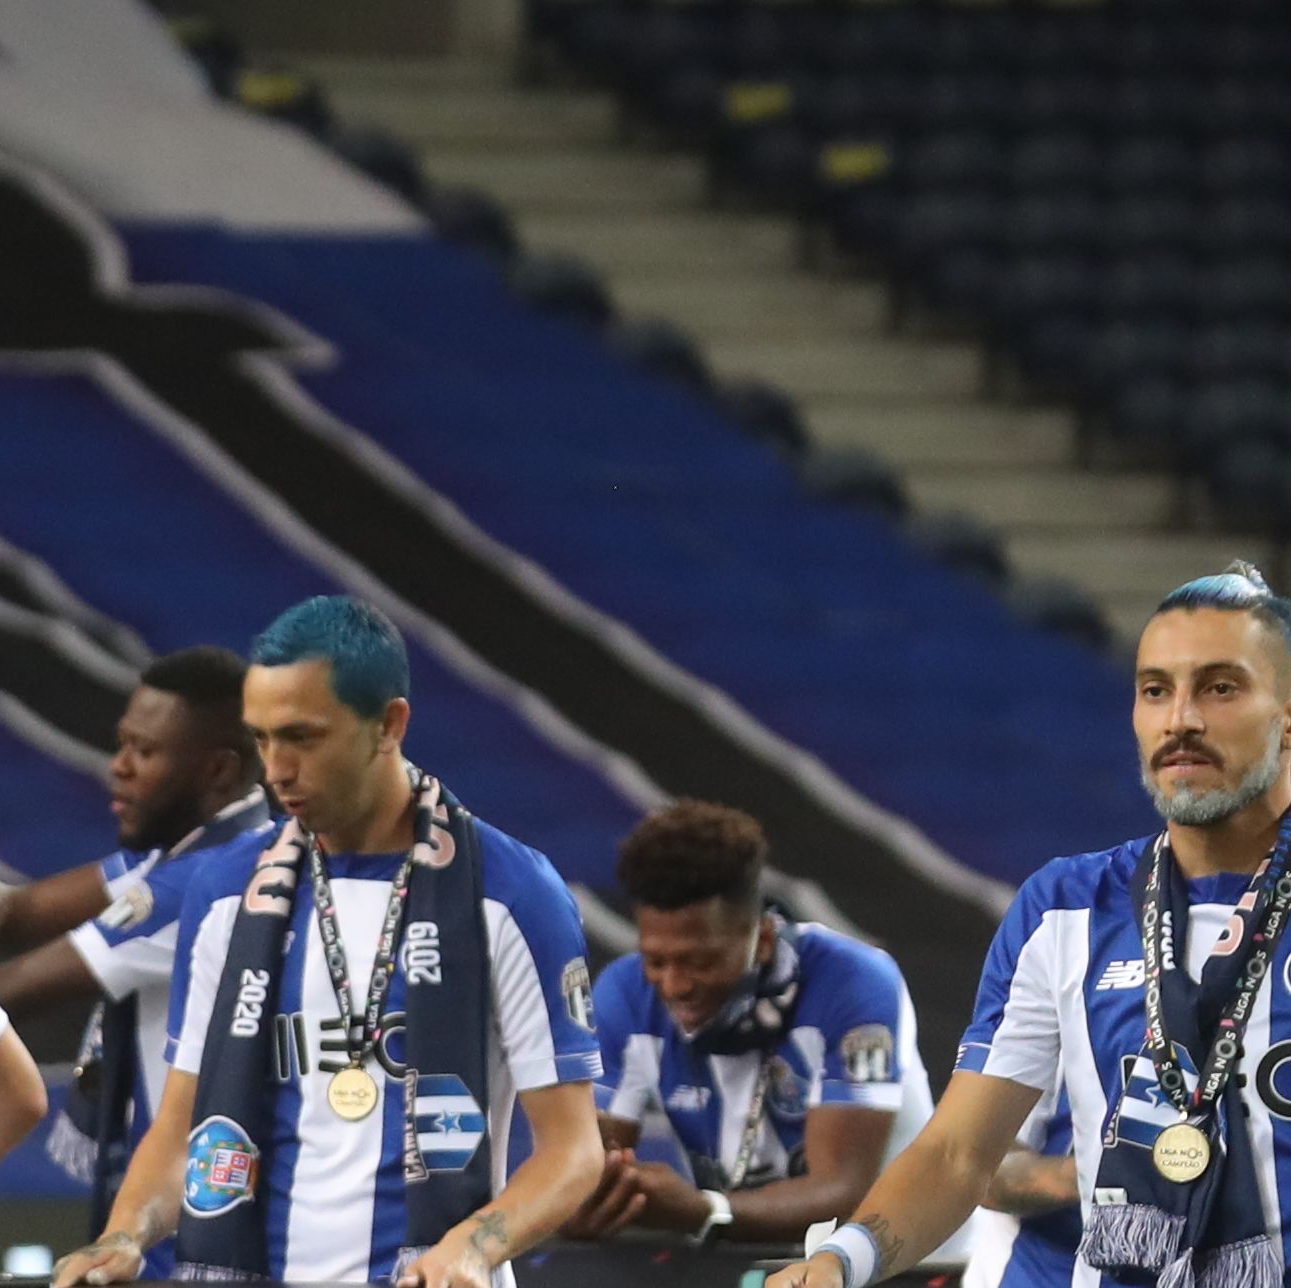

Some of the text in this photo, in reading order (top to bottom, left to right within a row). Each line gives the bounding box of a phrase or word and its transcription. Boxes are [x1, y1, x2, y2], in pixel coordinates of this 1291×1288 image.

[407, 921, 443, 986] 2019
[1264, 911, 1282, 939] LIGA
[230, 968, 270, 1038] 2020
[1233, 950, 1267, 1020] LIGA NOS
[1202, 1031, 1237, 1100] LIGA NOS
